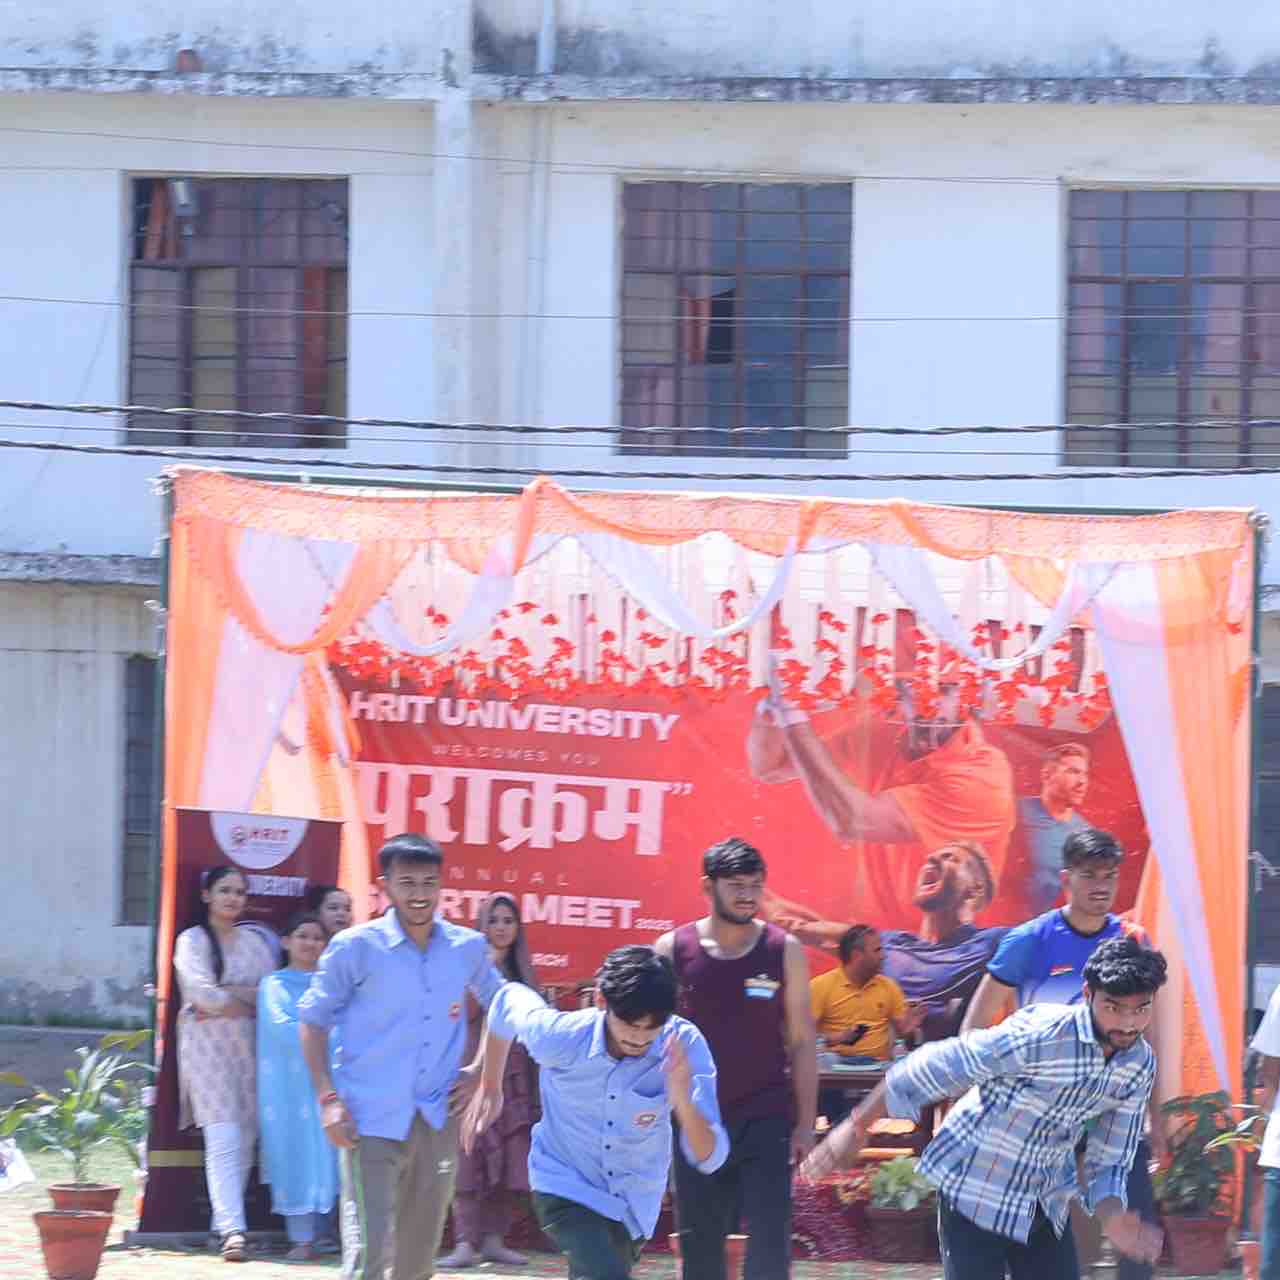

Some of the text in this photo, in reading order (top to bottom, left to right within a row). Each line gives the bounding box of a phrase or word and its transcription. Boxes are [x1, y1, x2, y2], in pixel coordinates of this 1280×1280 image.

[350, 690, 680, 742] HRIT UNIVERSITY
[432, 744, 600, 767] WELCOMES YOU
[450, 866, 569, 886] NNUAL
[521, 892, 641, 930] MEET
[531, 953, 569, 968] RCH
